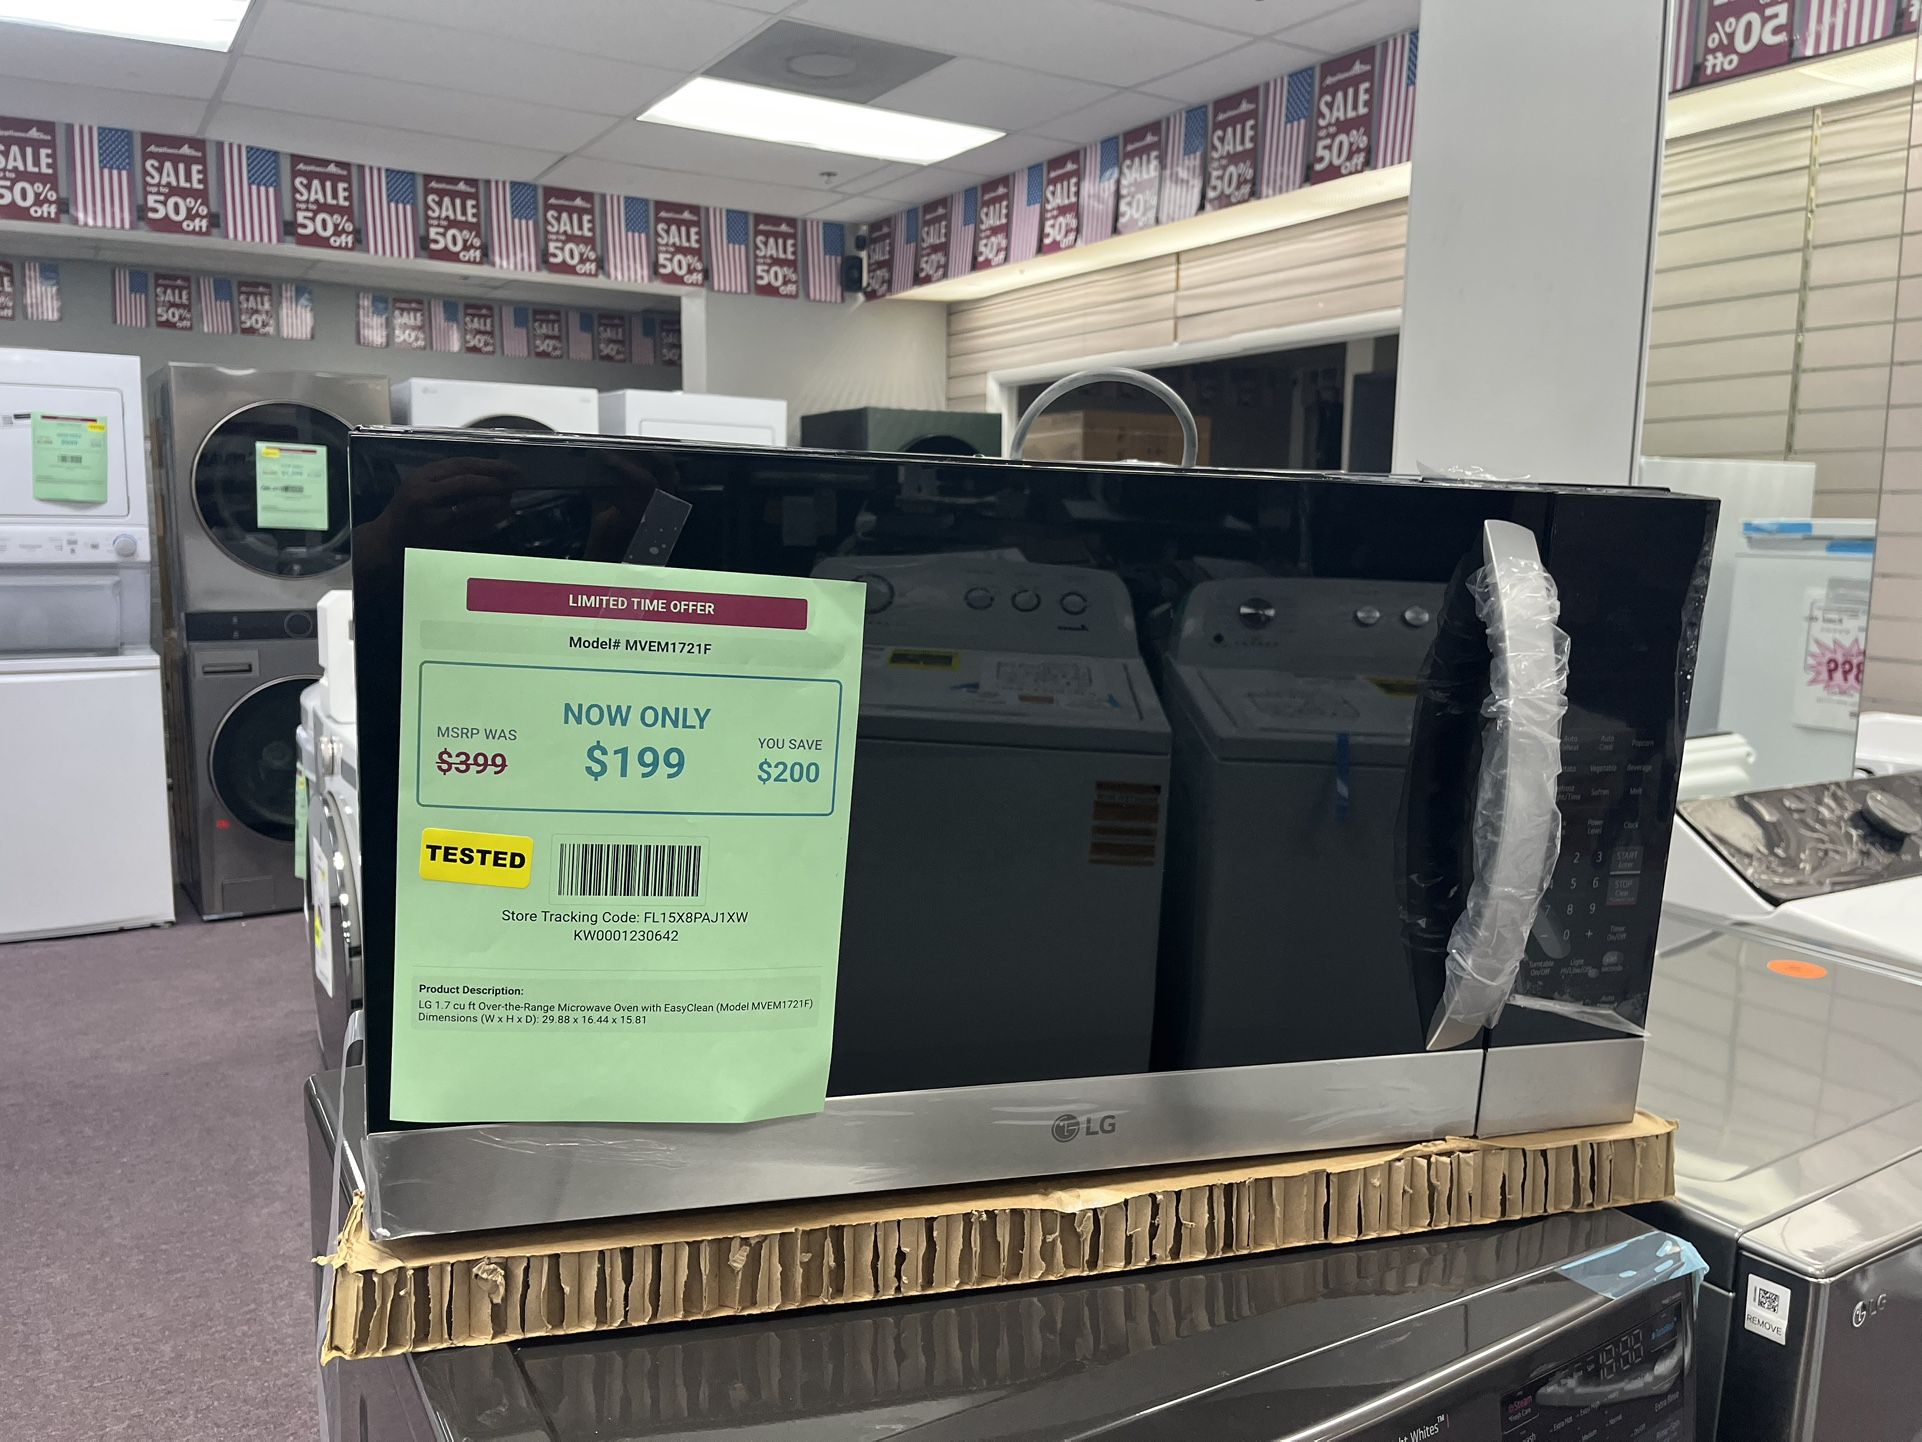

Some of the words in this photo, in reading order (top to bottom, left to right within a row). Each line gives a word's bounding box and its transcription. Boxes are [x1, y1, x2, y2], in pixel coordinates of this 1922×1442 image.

[1318, 81, 1371, 127] SALE
[1211, 119, 1255, 159] SALE
[1314, 126, 1368, 171] 50%
[145, 158, 204, 190] SALE
[1120, 151, 1160, 187] SALE
[1340, 151, 1365, 174] off
[1207, 159, 1254, 199] 50%
[294, 176, 349, 207] SALE
[1044, 176, 1078, 210] SALE
[29, 203, 57, 218] off
[147, 194, 208, 222] 50%
[426, 194, 478, 223] SALE
[979, 200, 1008, 231] SALE
[1119, 190, 1158, 223] 50%
[182, 218, 208, 232] off
[296, 210, 354, 238] 50%
[546, 210, 593, 237] SALE
[656, 222, 700, 248] SALE
[920, 220, 947, 248] SALE
[1043, 212, 1078, 244] 50%
[329, 233, 355, 248] off
[428, 226, 482, 252] 50%
[755, 235, 796, 260] SALE
[977, 232, 1008, 262] 50%
[458, 248, 482, 262] off
[548, 241, 596, 266] 50%
[658, 253, 703, 277] 50%
[575, 261, 597, 274] off
[683, 272, 704, 285] off
[756, 264, 798, 287] 50%
[156, 286, 189, 305] SALE
[778, 283, 798, 295] off
[239, 294, 272, 311] SALE
[157, 306, 192, 323] 50%
[568, 593, 627, 611] LIMITED
[631, 597, 667, 612] TIME
[670, 598, 715, 615] OFFER
[568, 636, 621, 650] Model#
[624, 639, 712, 655] MVEM1721F
[563, 702, 632, 727] NOW
[639, 705, 711, 730] ONLY
[437, 725, 480, 740] MSRP
[484, 727, 518, 741] WAS
[758, 737, 785, 750] YOU
[788, 738, 823, 751] SAVE
[435, 747, 508, 775] $399
[584, 740, 685, 782] $199
[757, 758, 820, 784] $200
[425, 843, 527, 870] TESTED
[1573, 852, 1580, 864] 2
[1595, 851, 1602, 863] 3
[1616, 850, 1638, 860] START
[1570, 877, 1577, 889] 5
[1592, 876, 1599, 888] 6
[501, 909, 537, 922] Store
[541, 911, 598, 925] Tracking
[602, 911, 640, 923] Code:
[644, 911, 748, 924] FL15X8PAJ1XW
[1566, 904, 1573, 915] 8
[1589, 903, 1596, 914] 9
[574, 929, 679, 942] KW0001230642
[1563, 929, 1570, 940] 0
[419, 984, 460, 994] Product
[462, 985, 524, 997] Description:
[419, 1000, 432, 1009] LG
[435, 1001, 450, 1010] 1.7
[468, 1001, 476, 1011] ft
[478, 1001, 555, 1013] Over-the-Range
[557, 1003, 611, 1012] Microwave
[613, 1003, 639, 1012] Oven
[641, 1003, 662, 1012] with
[664, 1003, 714, 1014] EasyClean
[716, 1002, 749, 1013] (Model
[751, 998, 813, 1011] MVEM1721F)
[418, 1013, 478, 1023] Dimensions
[480, 1014, 495, 1024] (W
[506, 1015, 514, 1023] H
[525, 1015, 540, 1025] D):
[542, 1015, 570, 1024] 29.88
[582, 1015, 609, 1024] 16.44
[620, 1015, 646, 1024] 15.81
[1085, 1114, 1116, 1136] LG
[1869, 1293, 1887, 1318] LG
[1746, 1313, 1782, 1336] REMOVE
